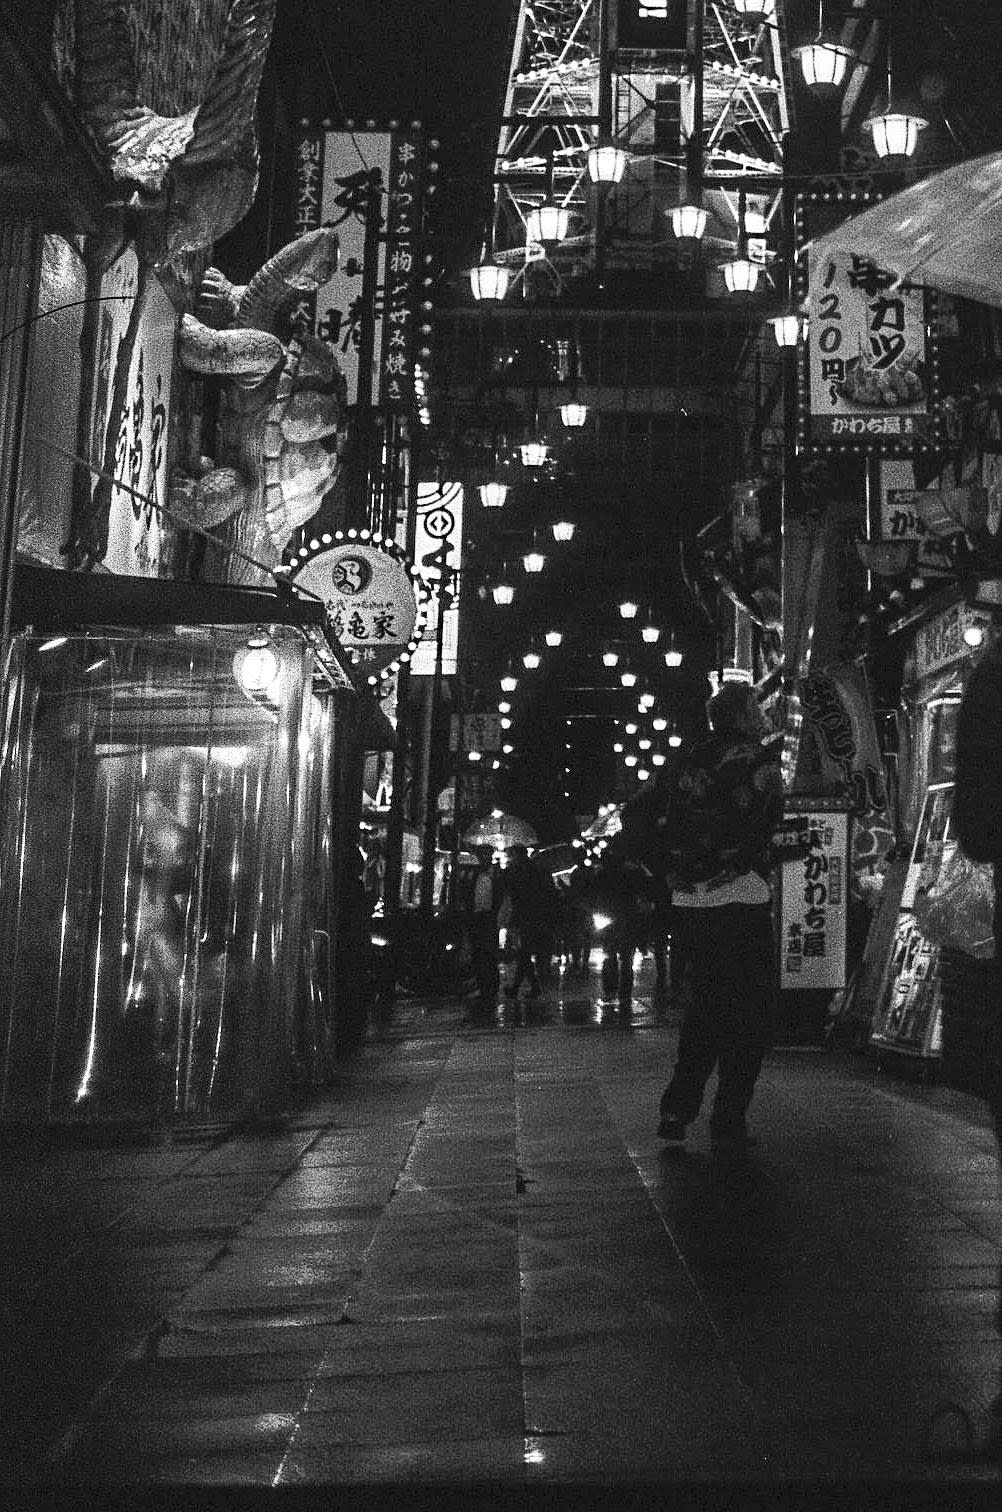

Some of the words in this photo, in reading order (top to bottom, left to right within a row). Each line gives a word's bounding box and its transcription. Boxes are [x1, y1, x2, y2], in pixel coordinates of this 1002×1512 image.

[297, 139, 319, 236] 創業大正
[848, 252, 905, 370] 串カツ
